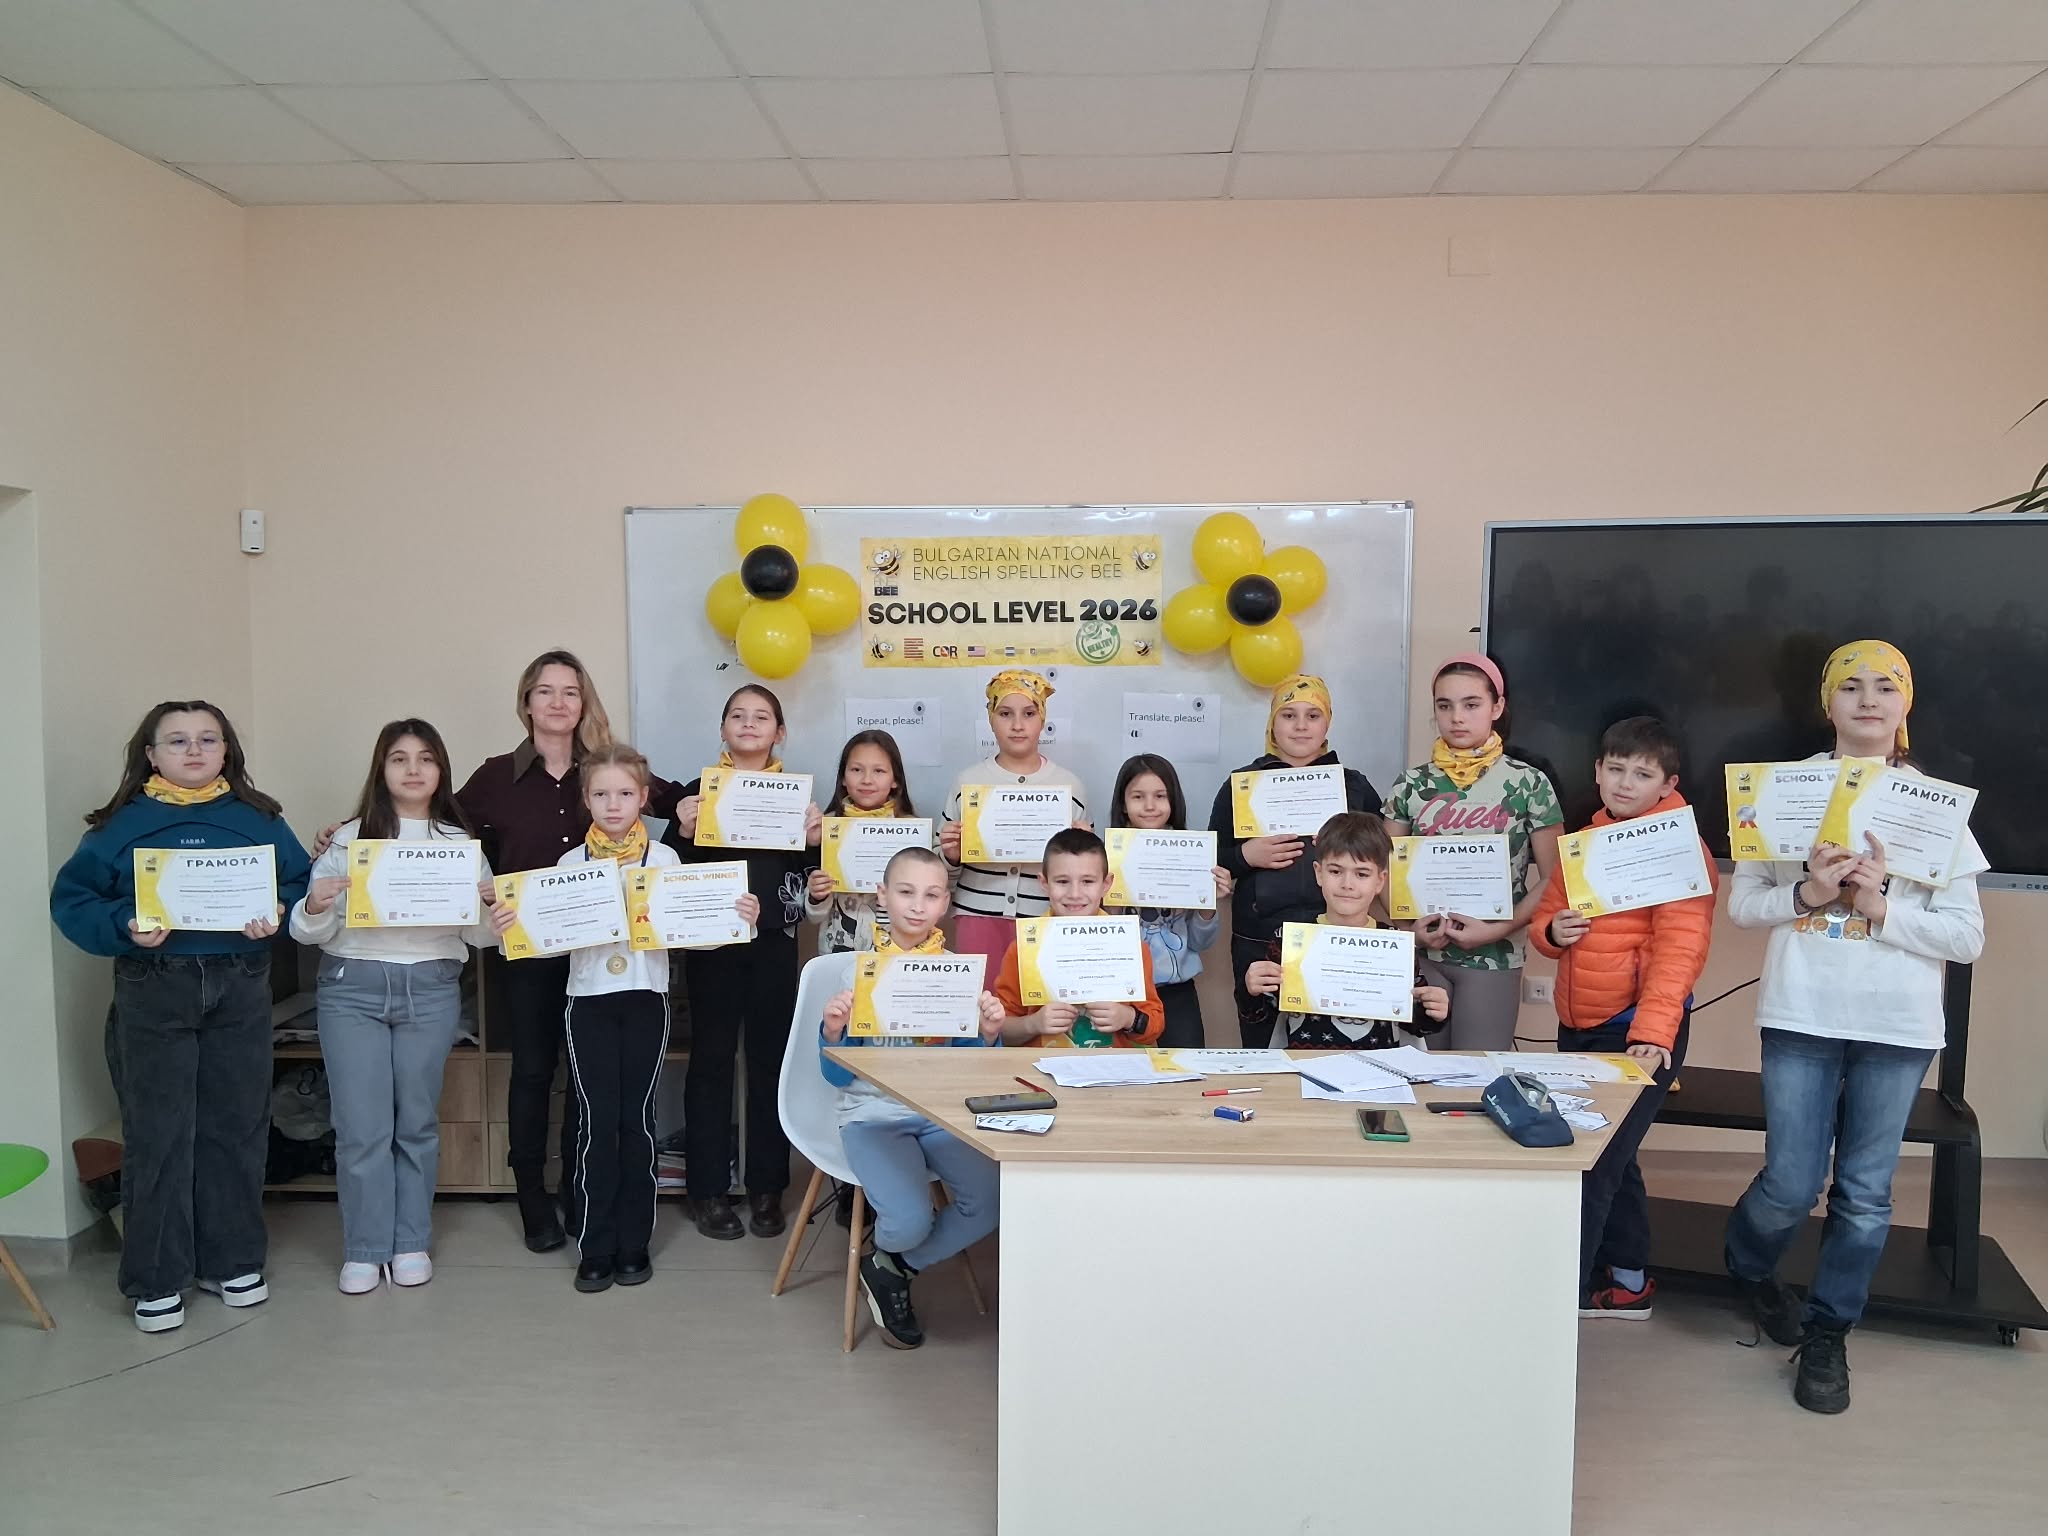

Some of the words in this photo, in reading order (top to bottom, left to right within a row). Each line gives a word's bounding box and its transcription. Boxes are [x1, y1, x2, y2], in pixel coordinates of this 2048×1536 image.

[913, 547, 1019, 562] BULGARIAN
[1027, 545, 1121, 560] NATIONAL
[913, 565, 990, 580] ENGLISH
[996, 564, 1083, 580] SPELLING
[1091, 563, 1121, 579] BEE
[874, 586, 899, 597] BEE
[867, 602, 987, 625] SCHOOL
[993, 601, 1075, 623] LEVEL
[1079, 599, 1158, 621] 2026
[857, 717, 891, 726] Repeat,
[892, 716, 924, 726] please!
[1129, 713, 1172, 722] Translate,
[1174, 714, 1205, 723] please!
[1273, 773, 1330, 783] ГРАМОТА
[1775, 774, 1824, 783] SCHOOL
[743, 780, 800, 791] ГРАМОТА
[1002, 794, 1059, 802] ГРАМОТА
[1892, 781, 1957, 807] ГРАМОТА
[863, 827, 919, 835] ГРАМОТА
[1608, 820, 1679, 843] ГРАМОТА
[1145, 838, 1204, 848] ГРАМОТА
[398, 850, 466, 859] ГРАМОТА
[1433, 845, 1495, 854] ГРАМОТА
[186, 857, 259, 868] ГРАМОТА
[541, 870, 605, 887] ГРАМОТА
[663, 874, 700, 882] SCHOOL
[702, 872, 738, 880] WINNER
[1063, 926, 1126, 935] ГРАМОТА
[1330, 936, 1399, 949] ГРАМОТА
[904, 964, 970, 972] ГРАМОТА
